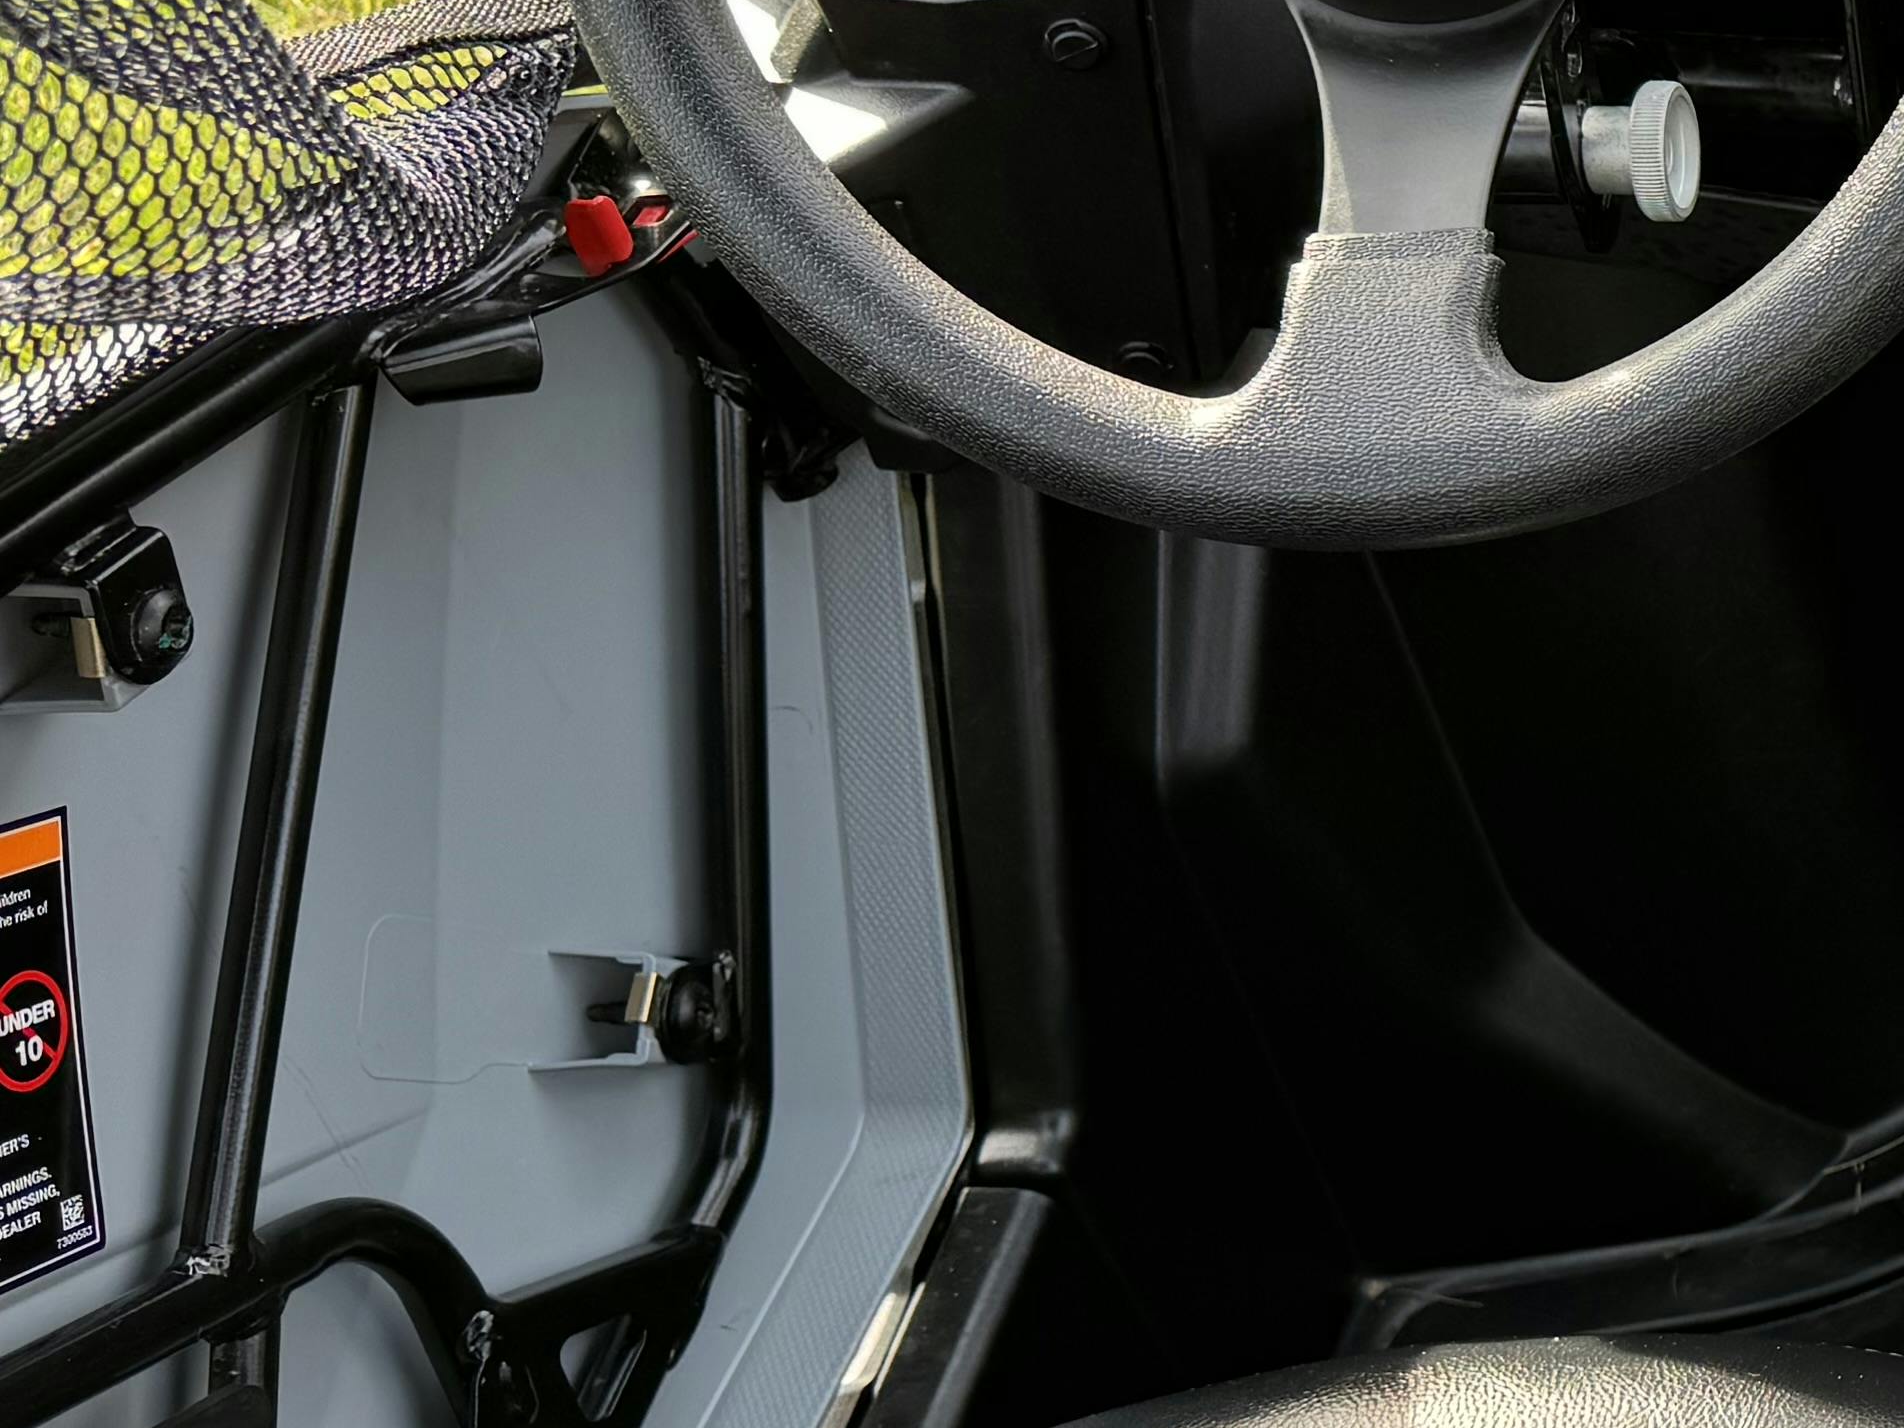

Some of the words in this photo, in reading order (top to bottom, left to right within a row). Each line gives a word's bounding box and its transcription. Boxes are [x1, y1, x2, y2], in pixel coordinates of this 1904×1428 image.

[14, 905, 35, 924] risk
[36, 899, 48, 916] of
[0, 999, 56, 1038] UNDER
[15, 1035, 44, 1066] 10
[6, 1184, 61, 1217] MISSING,
[0, 1211, 41, 1241] EALER
